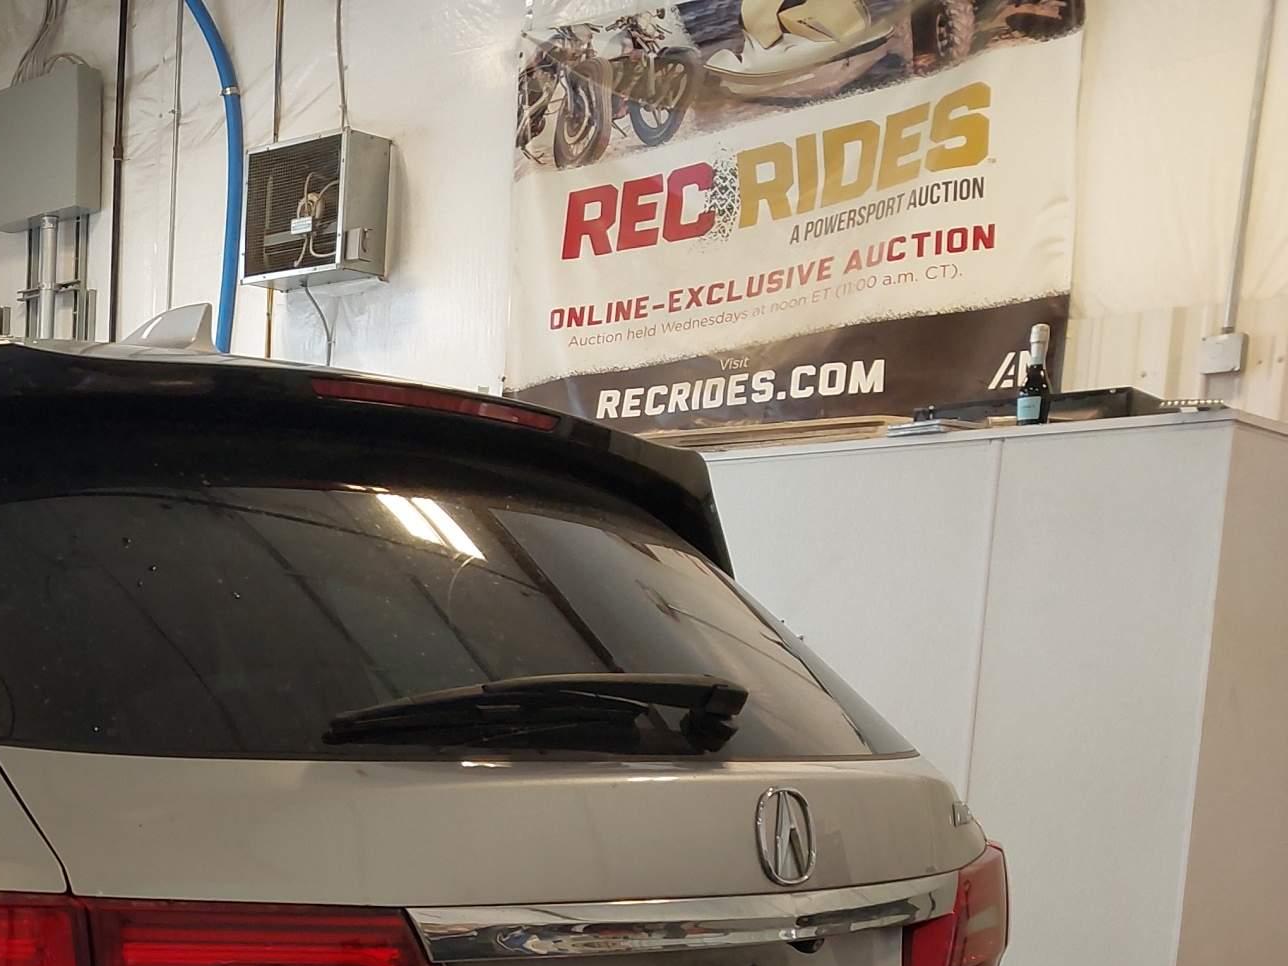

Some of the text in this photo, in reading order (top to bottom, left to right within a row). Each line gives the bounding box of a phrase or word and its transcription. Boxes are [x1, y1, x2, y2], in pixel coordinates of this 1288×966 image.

[736, 81, 992, 228] RIDES
[789, 176, 985, 245] A POWERSPORT AUCTION
[550, 223, 996, 330] ONLINE-EXCLUSIVE AUCTION
[567, 331, 623, 348] Auction
[627, 324, 656, 341] held
[661, 308, 749, 335] Wednesdays
[751, 305, 765, 318] at
[770, 296, 806, 312] noon
[811, 287, 831, 304] ET
[882, 271, 918, 286] a.m.
[925, 263, 962, 281] CT).
[596, 359, 885, 419] RECRIDES.COM
[720, 356, 750, 371] Visit
